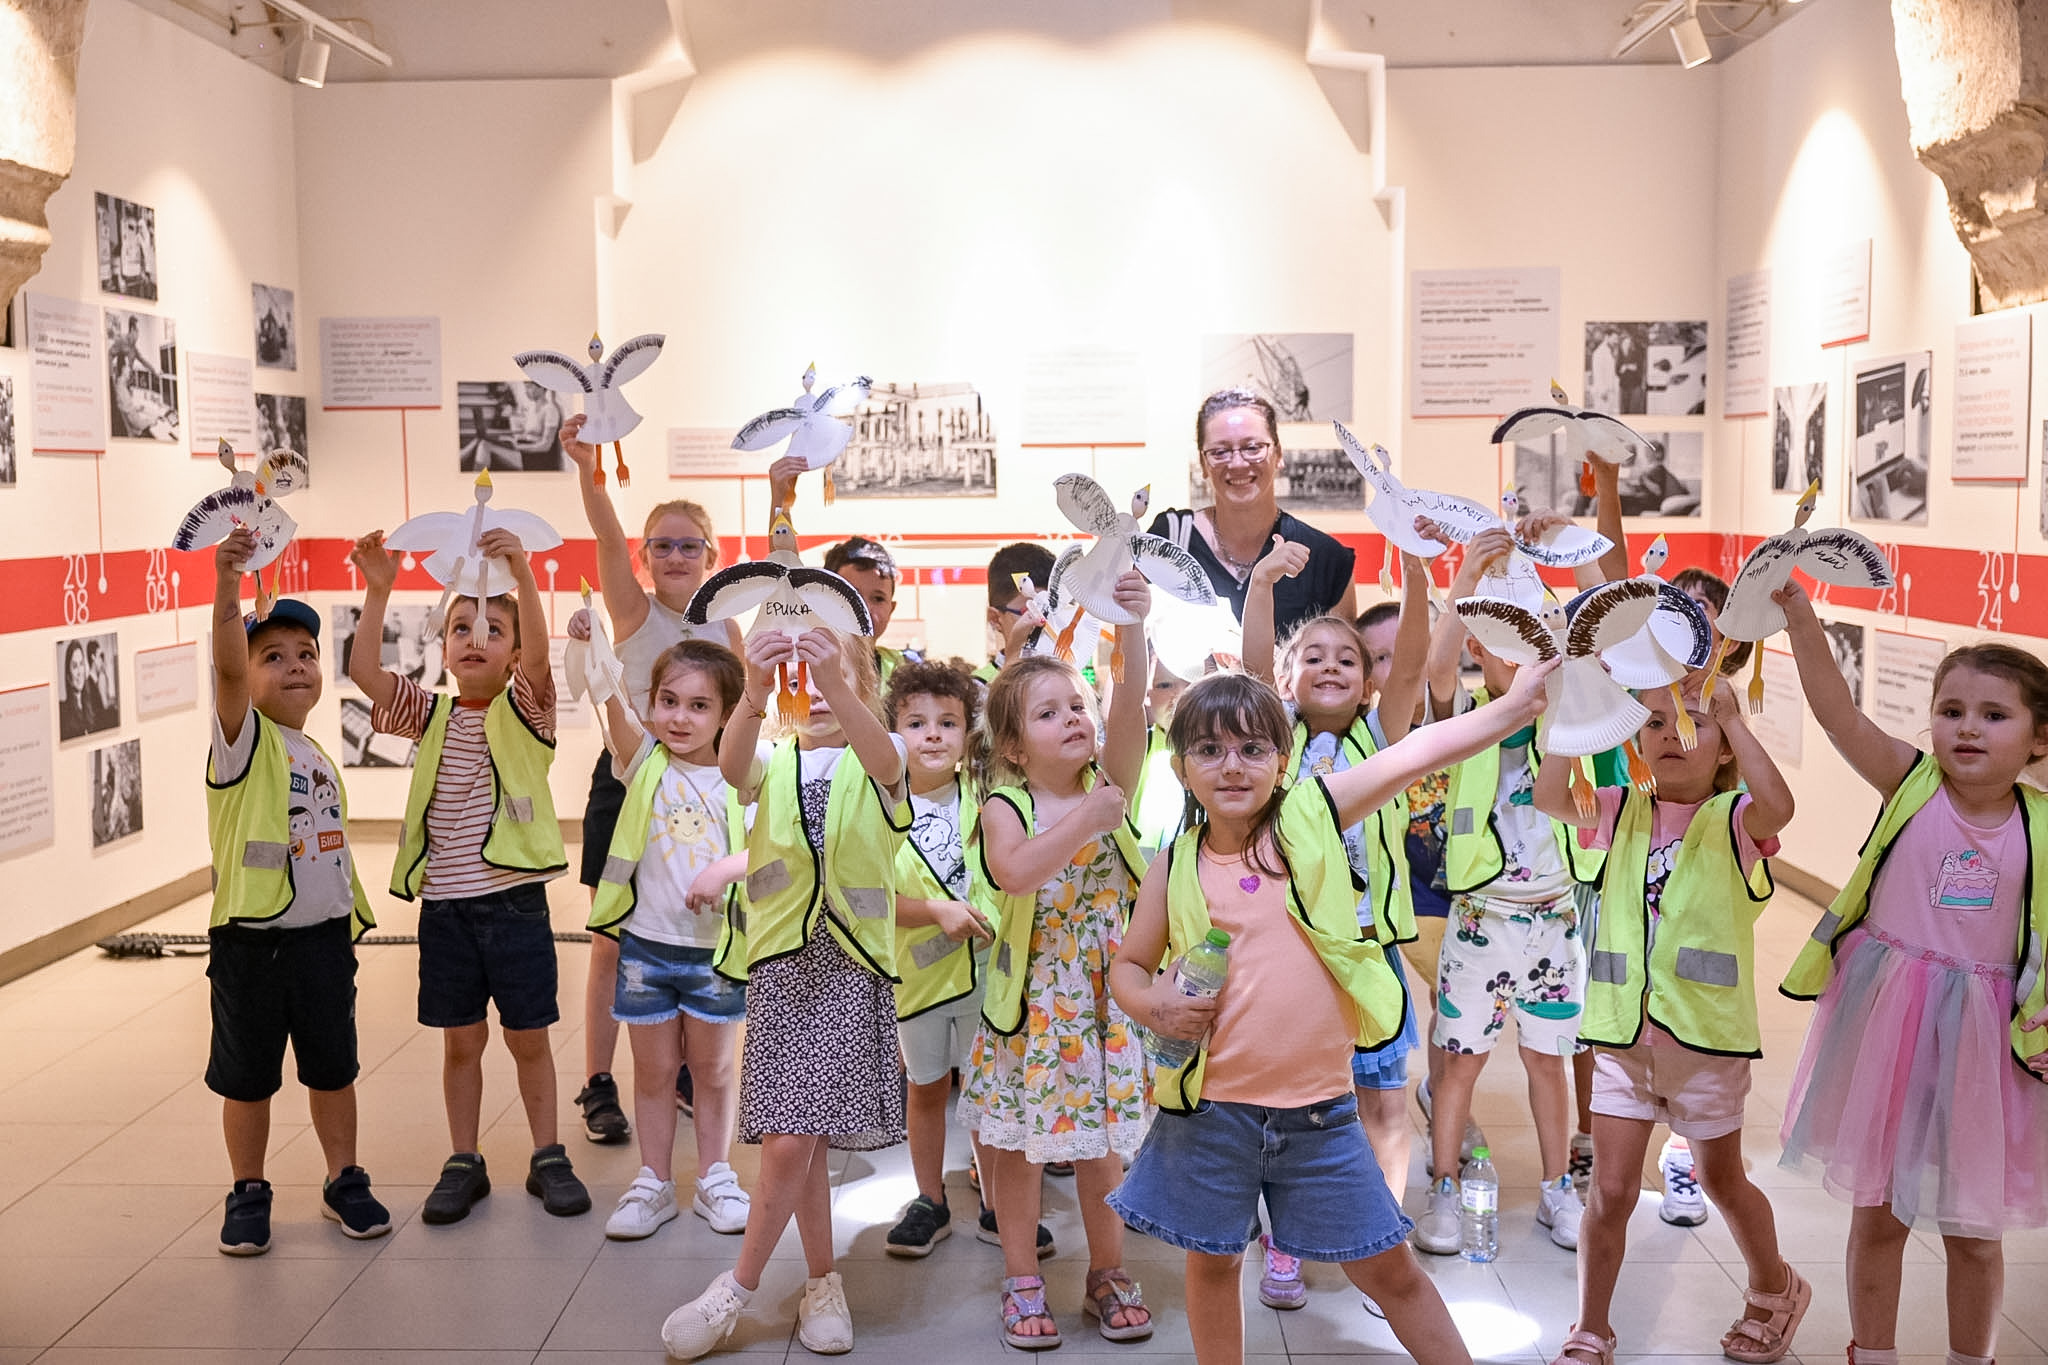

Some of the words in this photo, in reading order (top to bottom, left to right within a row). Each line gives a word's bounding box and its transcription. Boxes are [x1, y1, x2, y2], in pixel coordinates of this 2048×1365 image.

[62, 554, 88, 590] 20
[146, 549, 168, 580] 20
[1978, 551, 2005, 591] 20
[63, 589, 89, 626] 08
[146, 580, 169, 614] 09
[1977, 590, 2003, 632] 24
[291, 776, 307, 793] БИ
